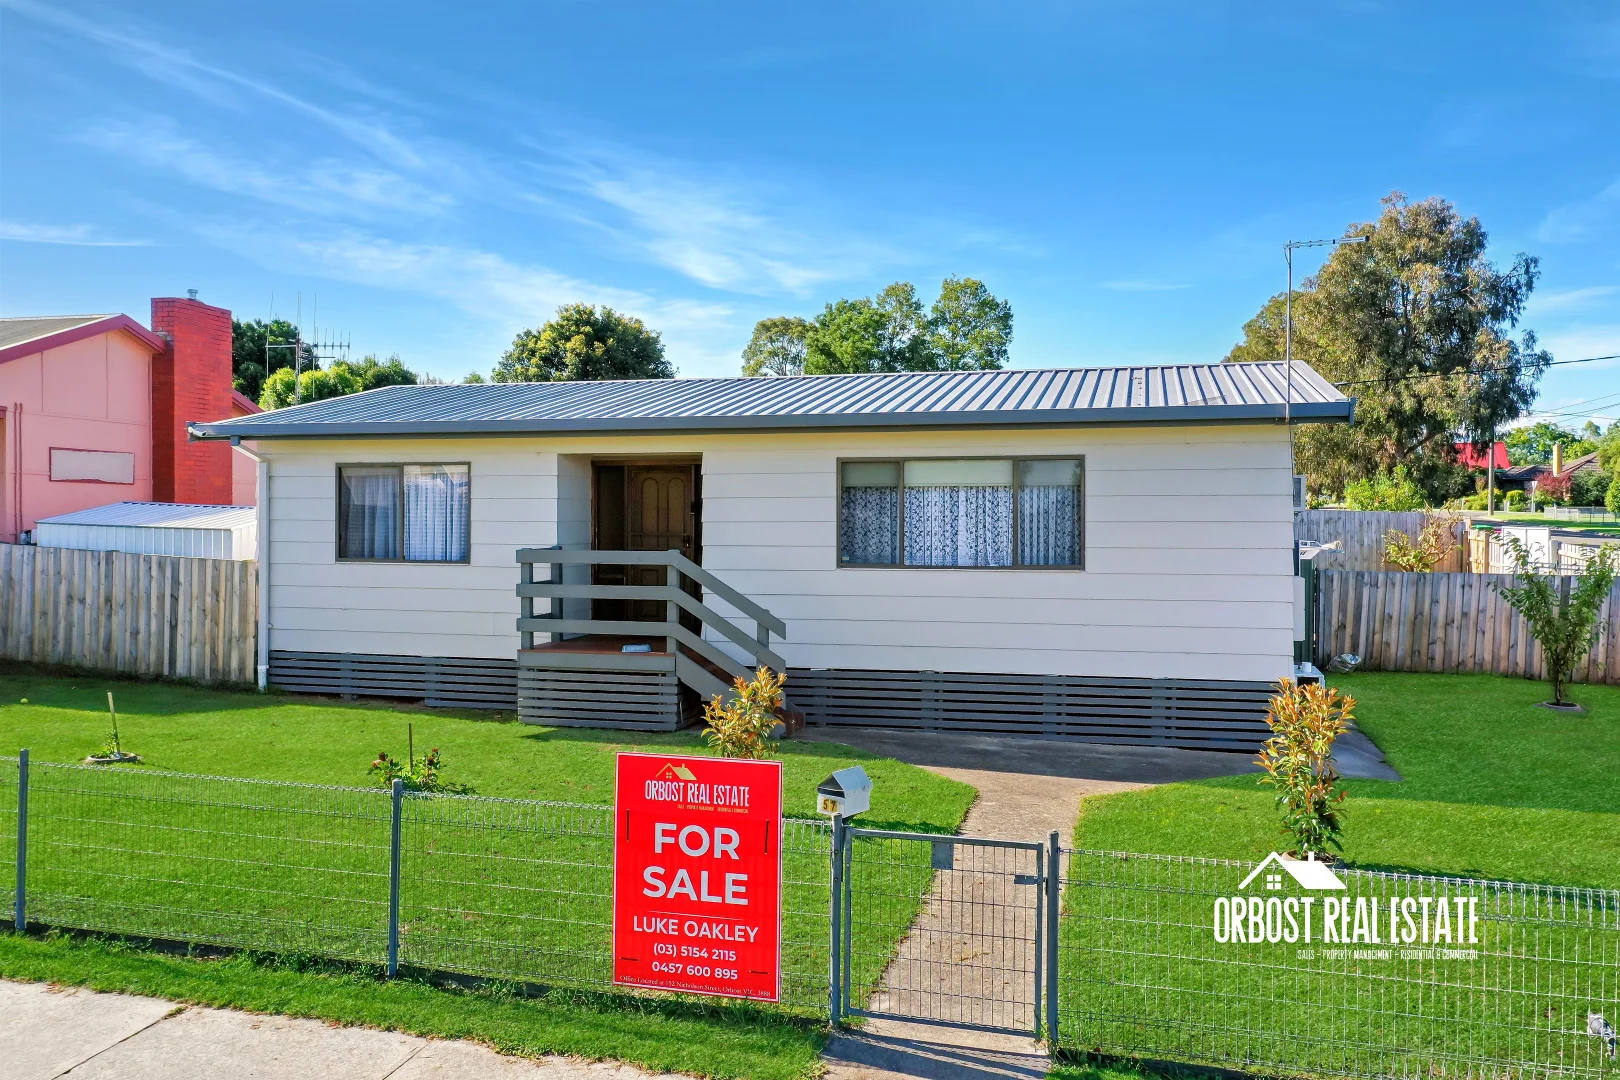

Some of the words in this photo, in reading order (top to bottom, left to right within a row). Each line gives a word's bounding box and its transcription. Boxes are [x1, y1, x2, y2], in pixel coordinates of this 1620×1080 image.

[644, 780, 684, 802] ORBOST
[688, 782, 710, 804] REAL
[714, 784, 750, 807] ESTATE
[823, 798, 836, 812] 57
[654, 822, 740, 860] FOR
[642, 865, 748, 906] SALE
[633, 915, 679, 936] LUKE
[683, 920, 759, 942] OAKLEY
[653, 942, 677, 958] (03)
[680, 946, 708, 959] 5154
[712, 948, 737, 962] 2115
[637, 976, 658, 984] Located
[652, 961, 683, 974] 0457
[686, 965, 711, 977] 600
[714, 968, 738, 980] 895
